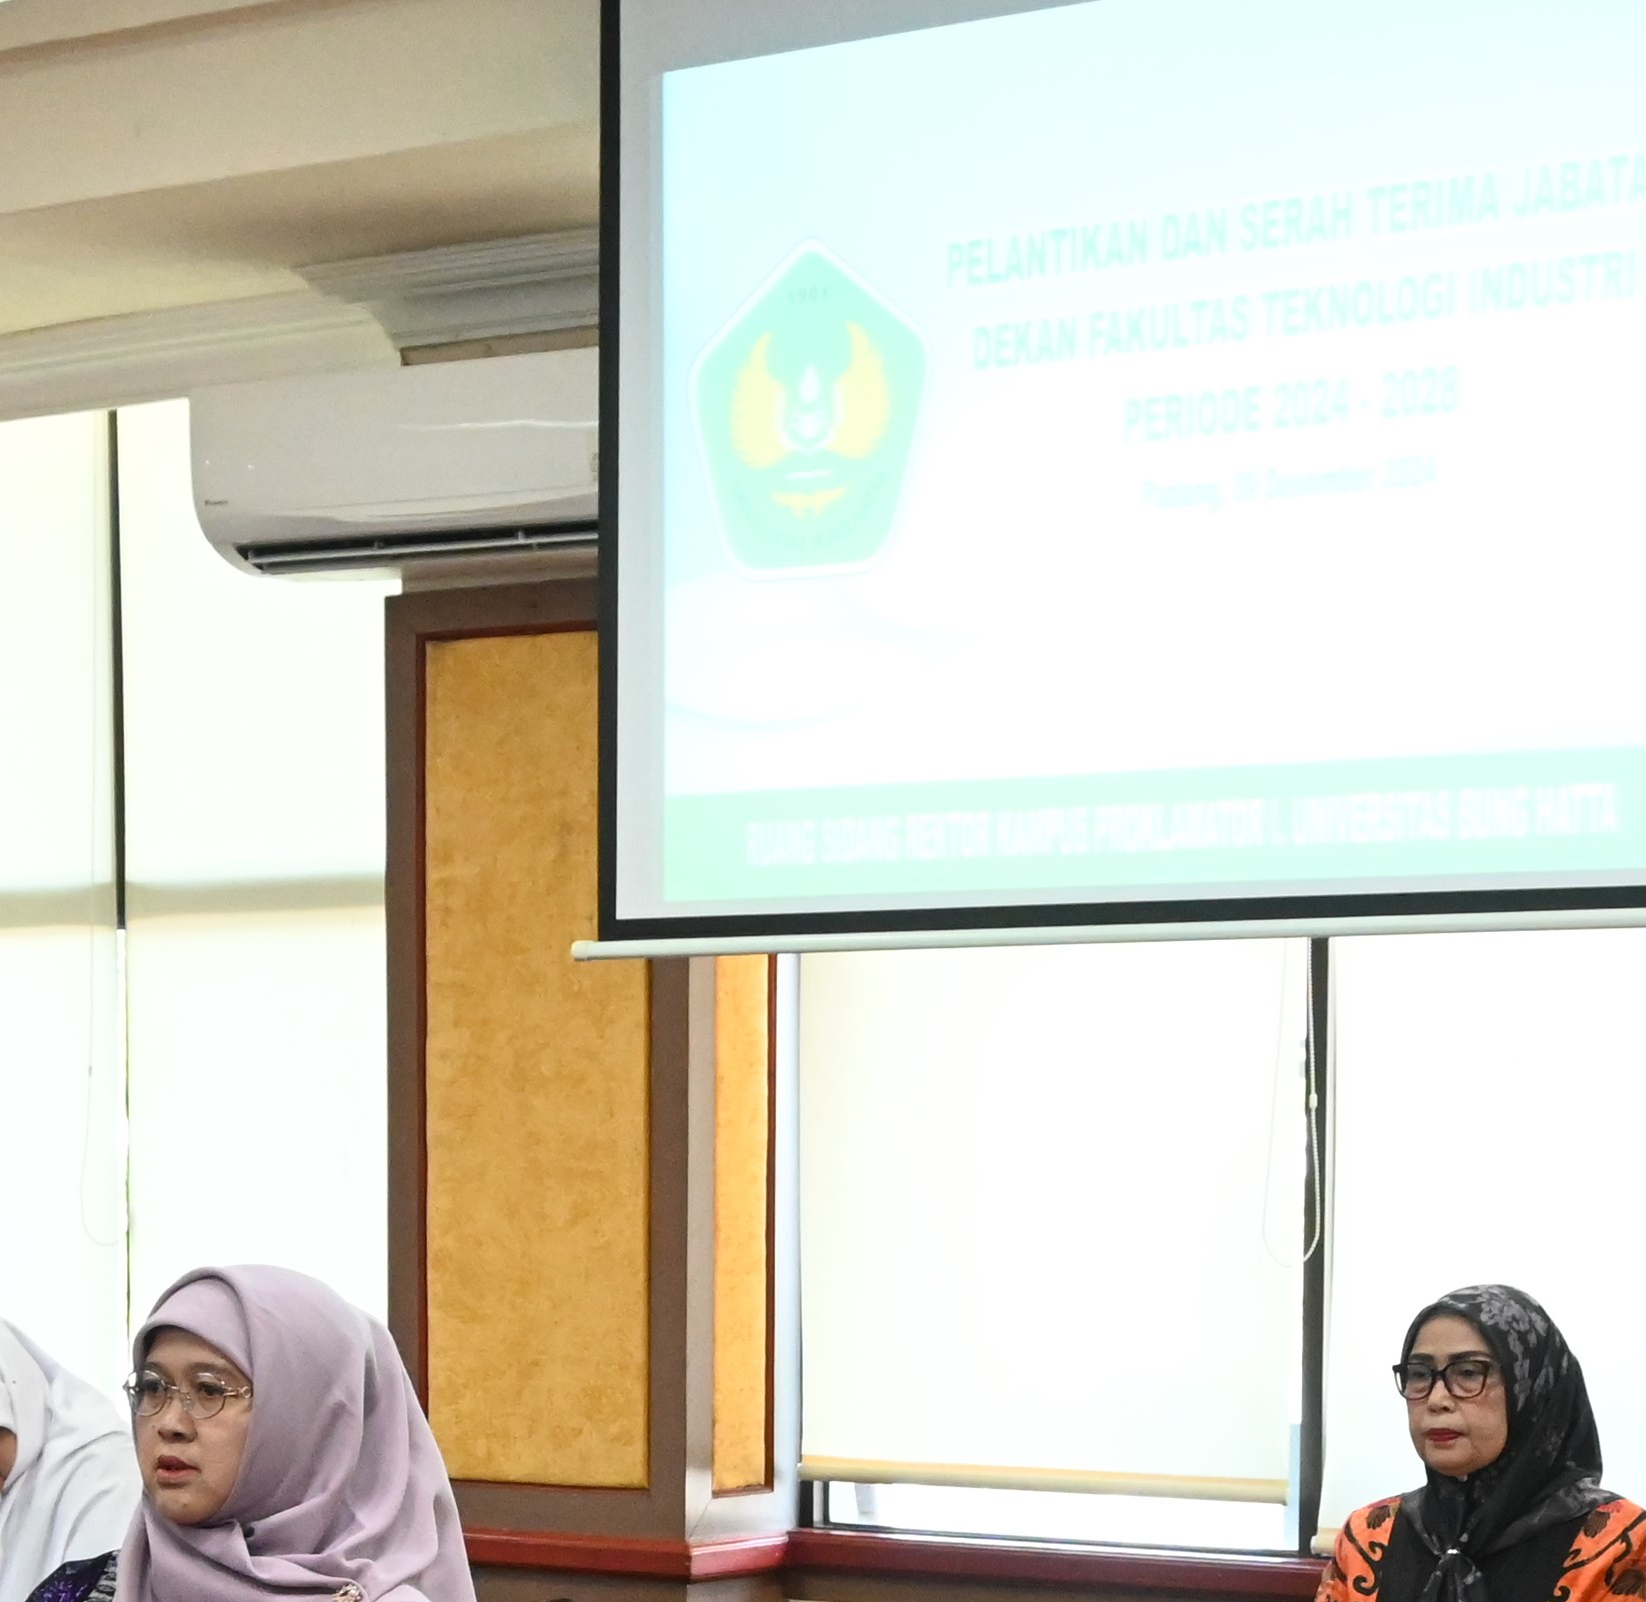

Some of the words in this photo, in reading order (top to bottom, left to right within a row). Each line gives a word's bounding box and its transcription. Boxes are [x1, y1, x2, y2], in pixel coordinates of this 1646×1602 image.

[945, 218, 1150, 289] PELANTIKAN
[1160, 207, 1228, 262] DAN
[1238, 189, 1353, 253] SERAH
[1366, 169, 1501, 235] TERIMA
[972, 317, 1078, 371] DEKAN
[1087, 294, 1250, 360] FAKULTAS
[1262, 270, 1456, 338] TEKNOLOGI
[1471, 246, 1640, 315] INDUSTRI
[1123, 385, 1262, 443] PERIODE
[1272, 376, 1352, 431] 2024
[1381, 364, 1462, 419] 2028
